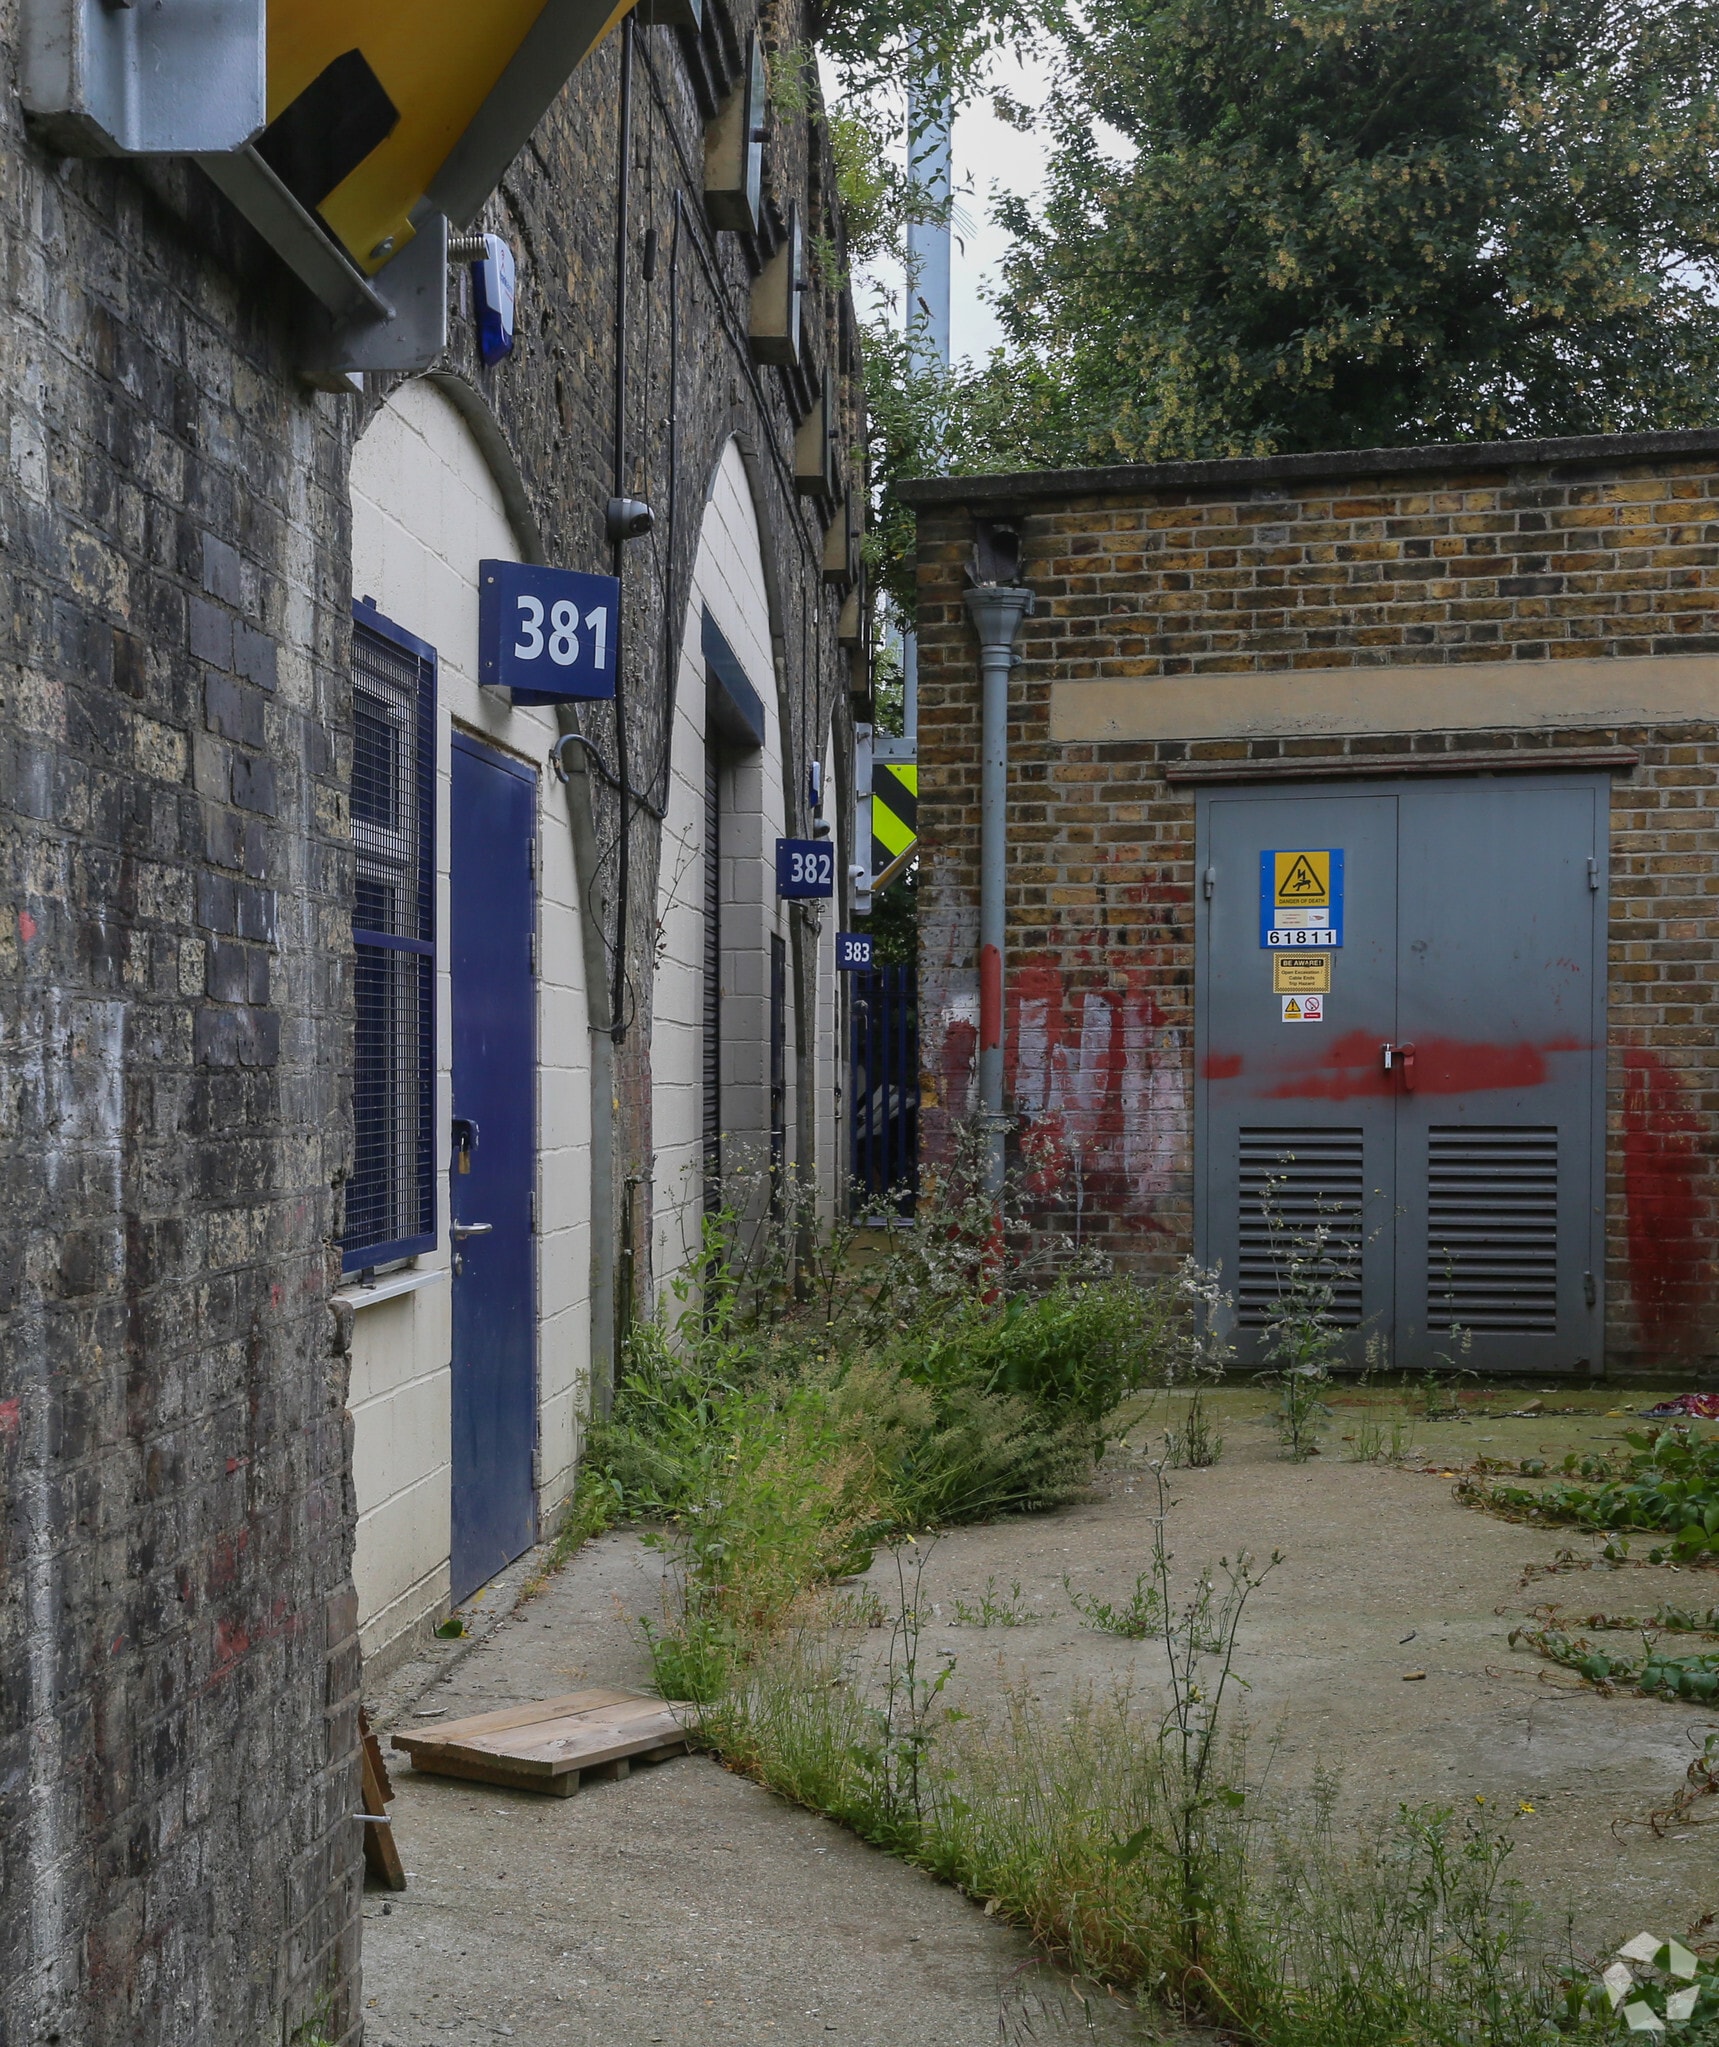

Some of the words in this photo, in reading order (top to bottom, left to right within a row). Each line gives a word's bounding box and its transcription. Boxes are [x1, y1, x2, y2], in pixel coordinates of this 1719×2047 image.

[514, 595, 607, 669] 381
[791, 852, 831, 884] 382
[1269, 931, 1332, 945] 61811
[844, 941, 870, 962] 383
